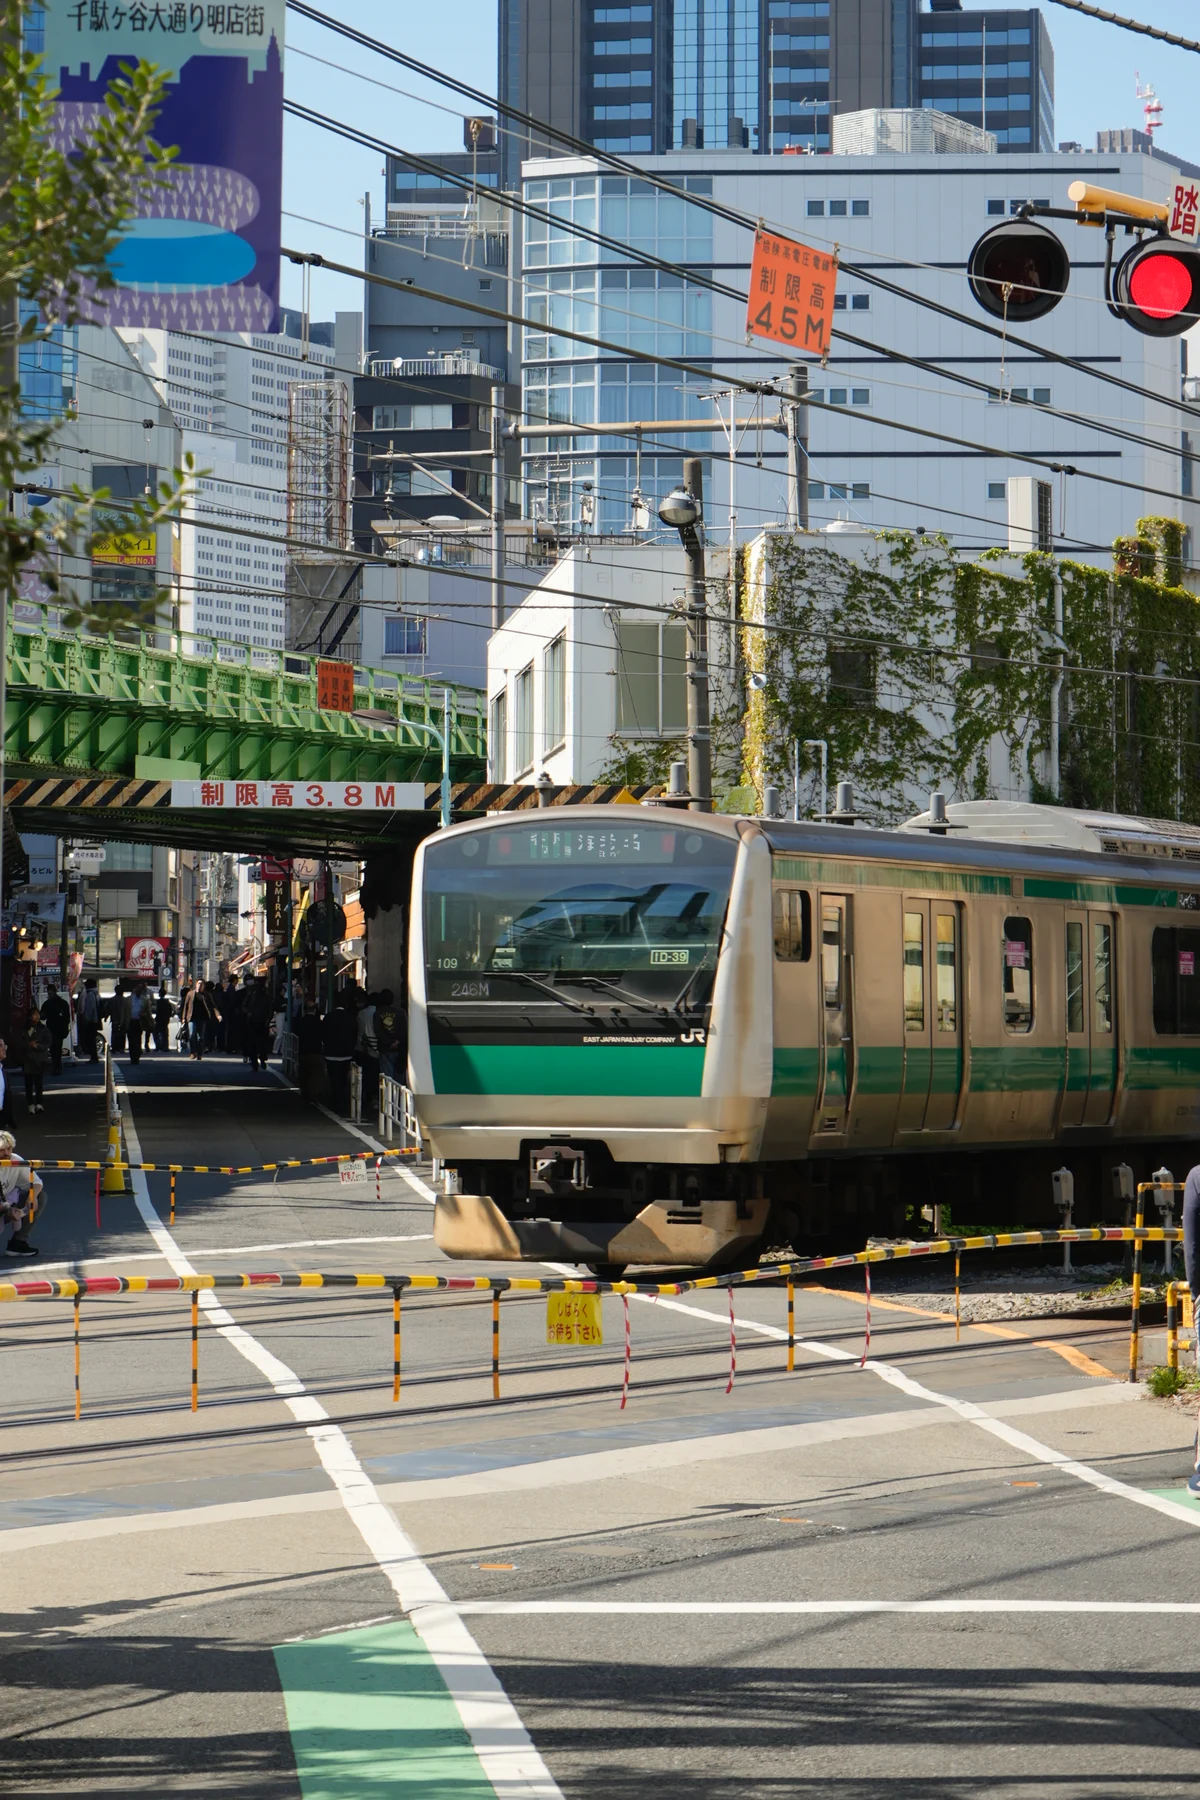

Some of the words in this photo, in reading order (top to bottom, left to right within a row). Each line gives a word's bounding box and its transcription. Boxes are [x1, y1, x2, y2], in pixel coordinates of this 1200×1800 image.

[1170, 184, 1199, 237] 踏
[761, 238, 830, 272] 危険高電圧電線
[759, 266, 826, 311] 制限高
[754, 300, 825, 349] 4.5M
[201, 782, 396, 808] 制限高3.8M
[437, 958, 458, 969] 109
[451, 982, 489, 997] 246M
[680, 1028, 706, 1044] JR
[557, 1302, 588, 1318] しばらく
[547, 1322, 601, 1341] お待ち下さい
